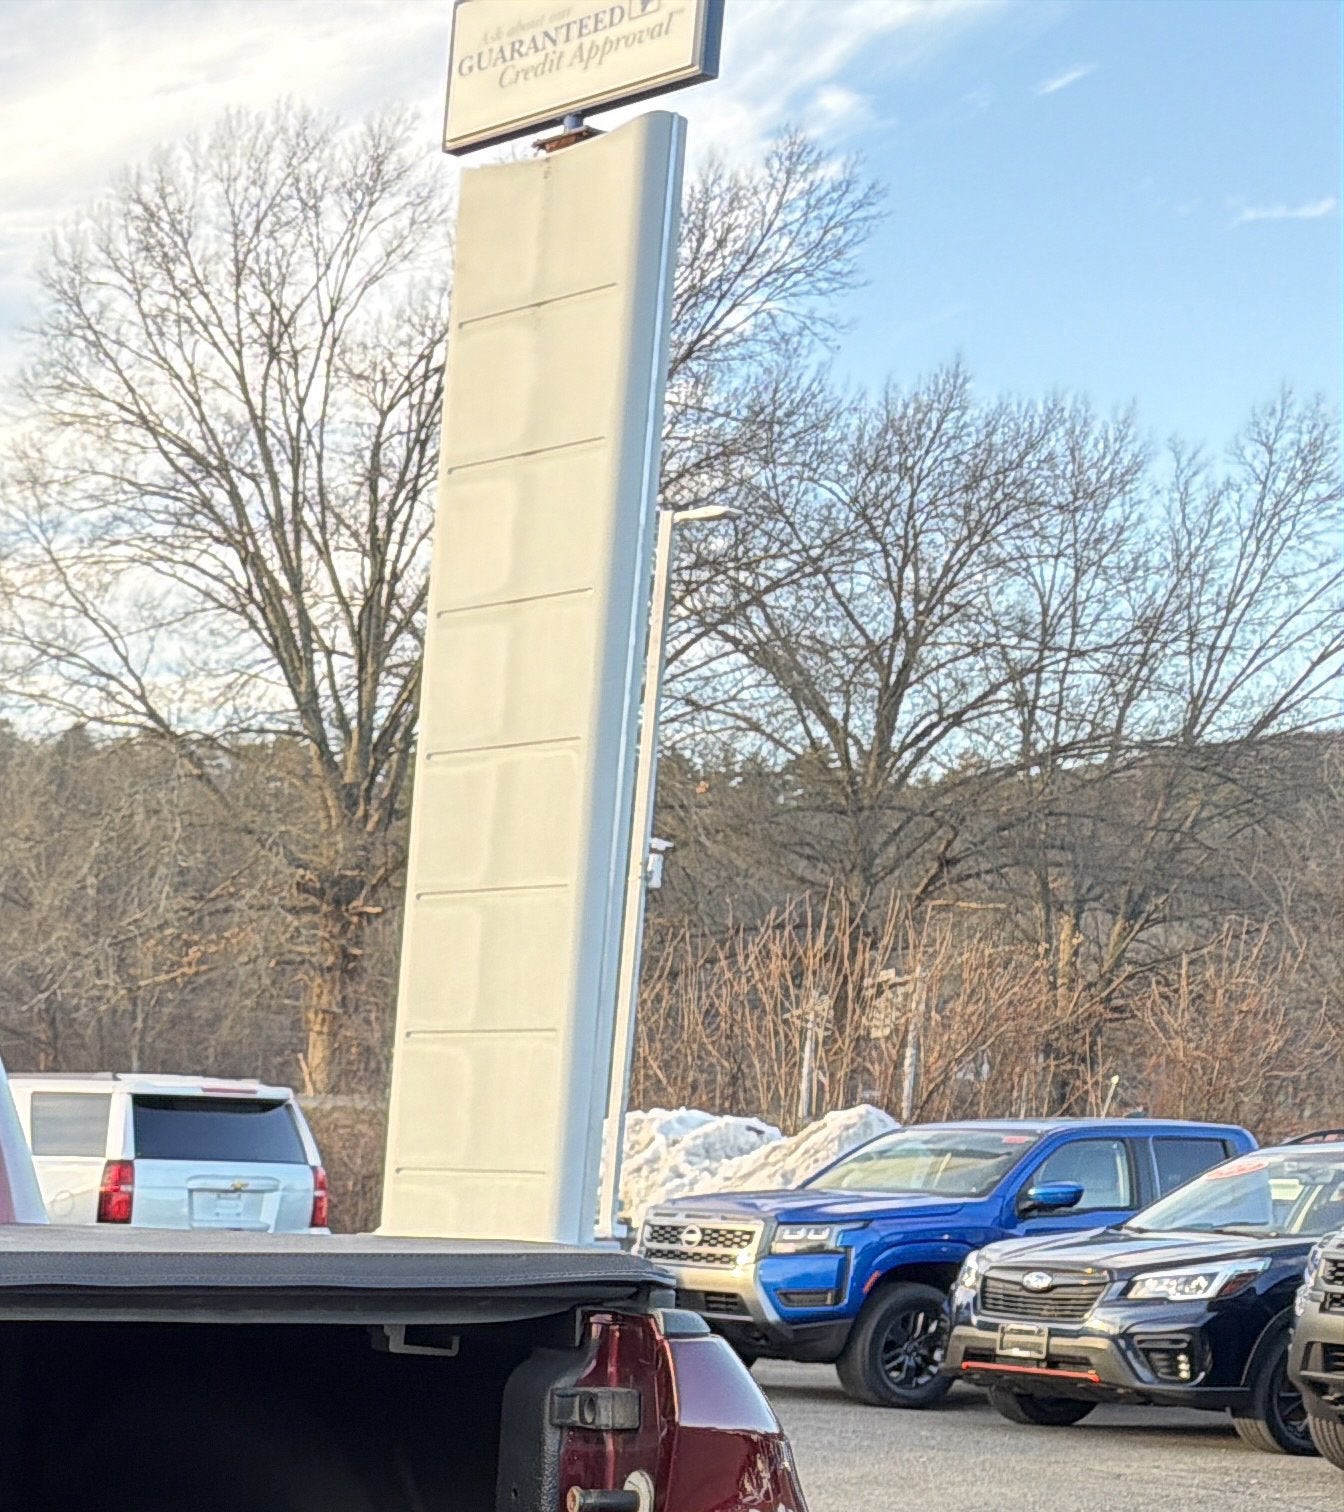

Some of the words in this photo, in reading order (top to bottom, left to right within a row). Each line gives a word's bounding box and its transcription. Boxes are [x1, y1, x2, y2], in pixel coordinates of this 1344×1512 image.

[458, 5, 626, 77] GUARANTEED
[498, 50, 564, 89] Credit
[568, 12, 673, 70] Approval
